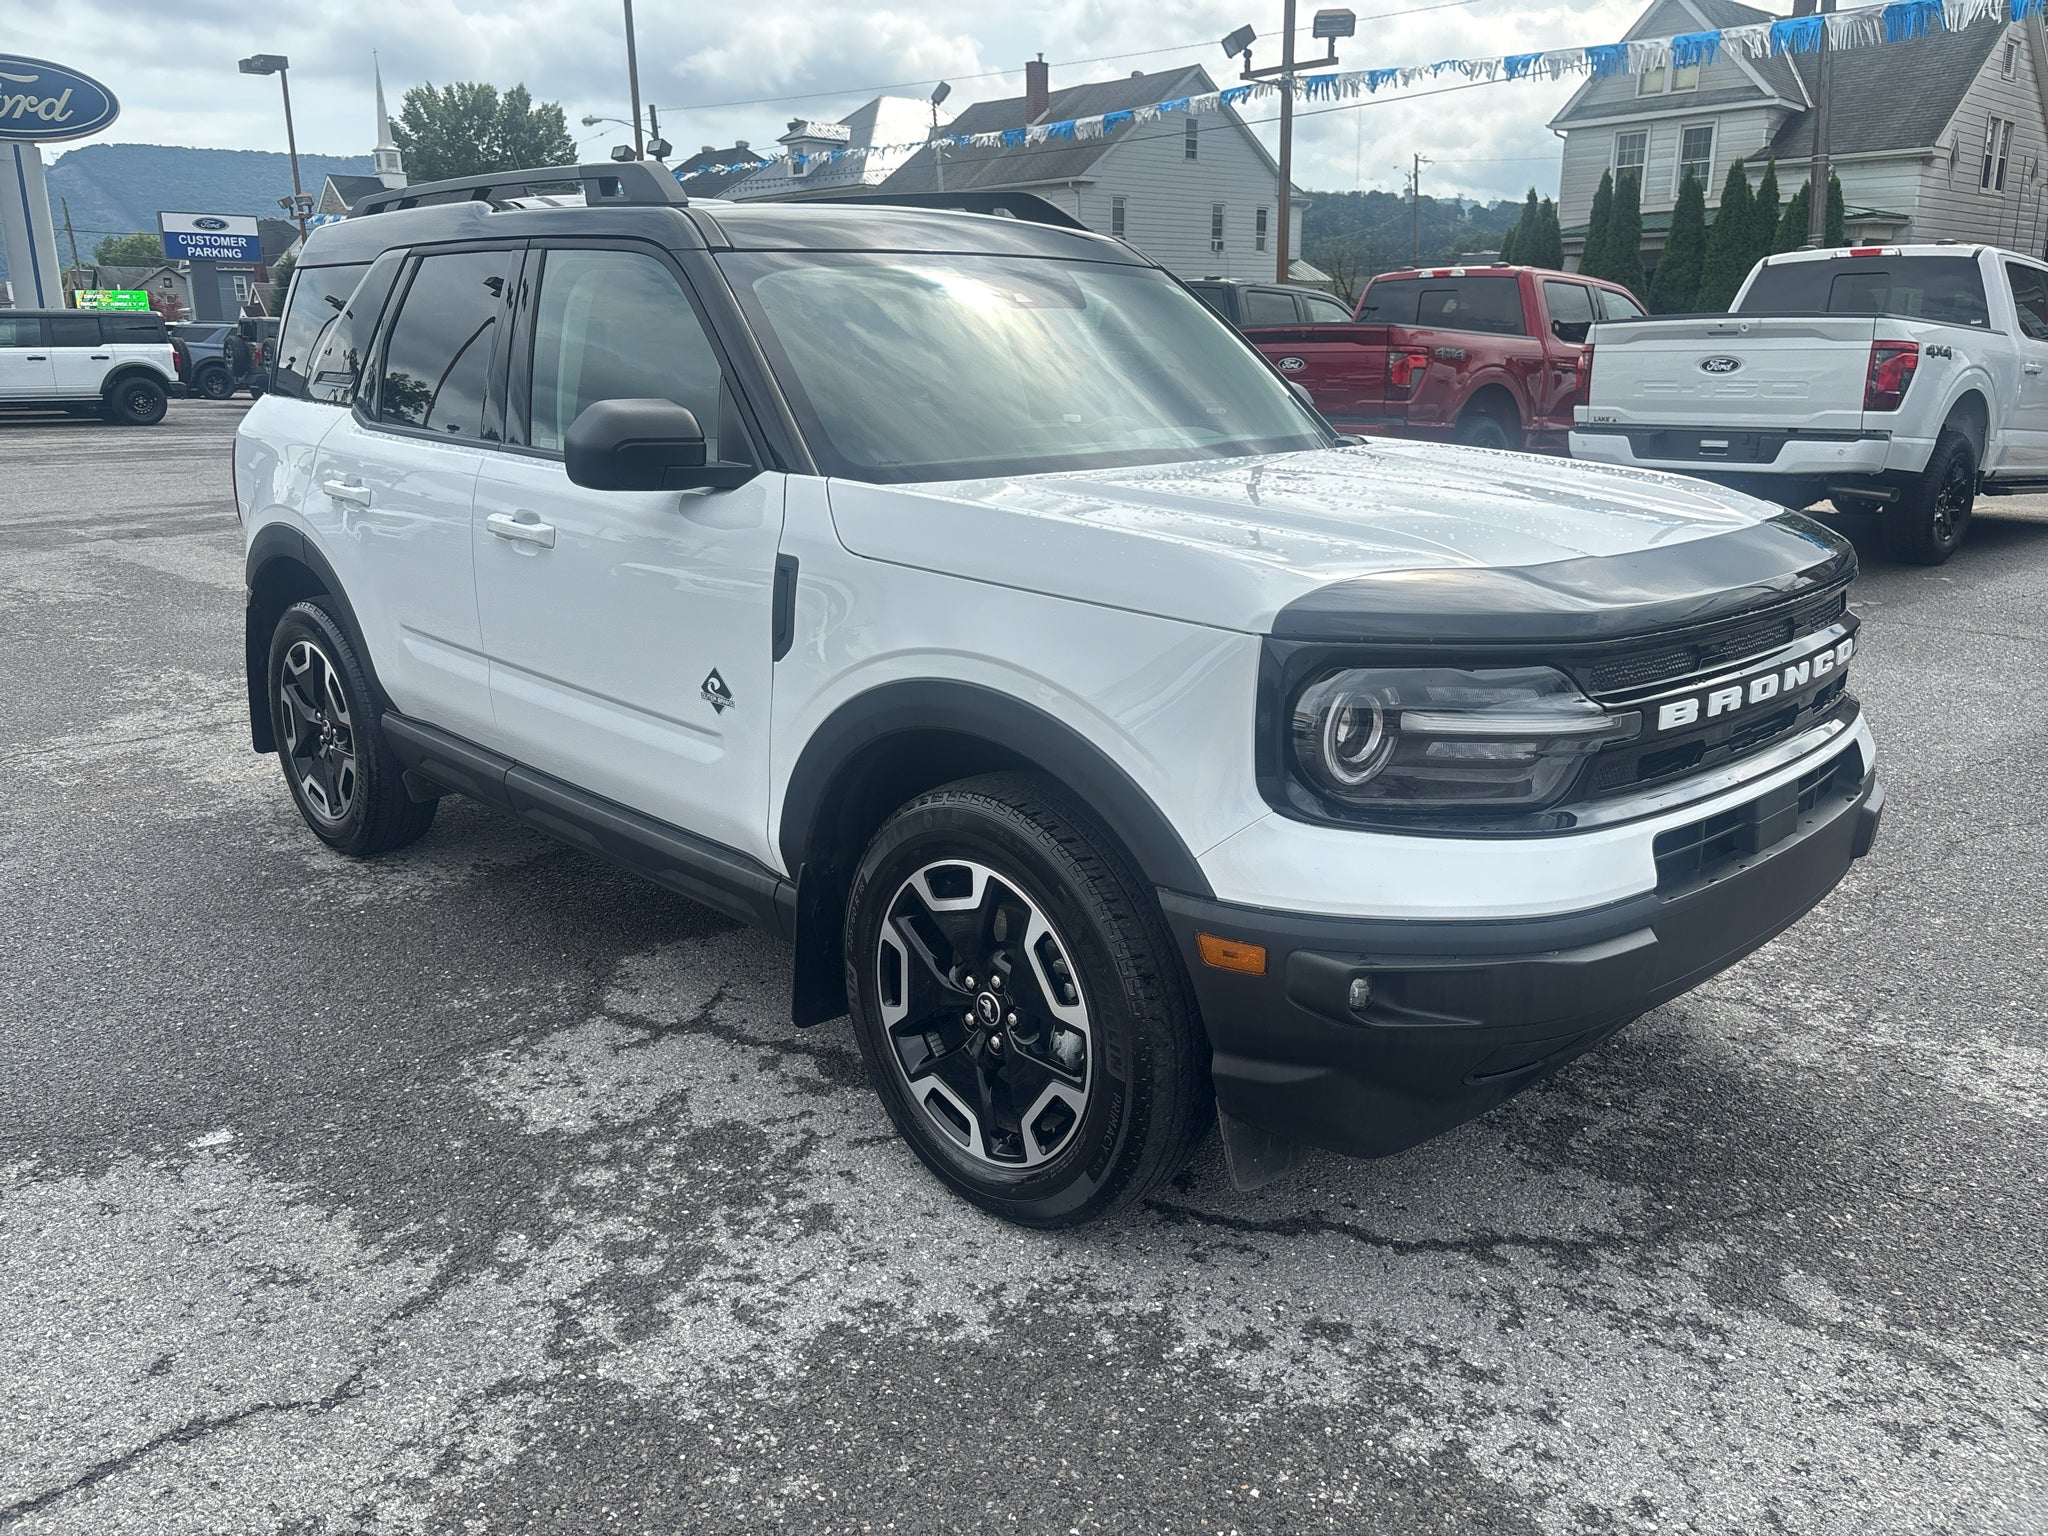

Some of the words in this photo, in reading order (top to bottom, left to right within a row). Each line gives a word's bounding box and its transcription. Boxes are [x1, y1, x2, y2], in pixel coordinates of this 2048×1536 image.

[0, 72, 74, 122] ord
[178, 234, 247, 247] CUSTOMER
[187, 246, 242, 258] PARKING
[1658, 638, 1852, 730] BRONCO
[1102, 1091, 1122, 1154] PRIMACY
